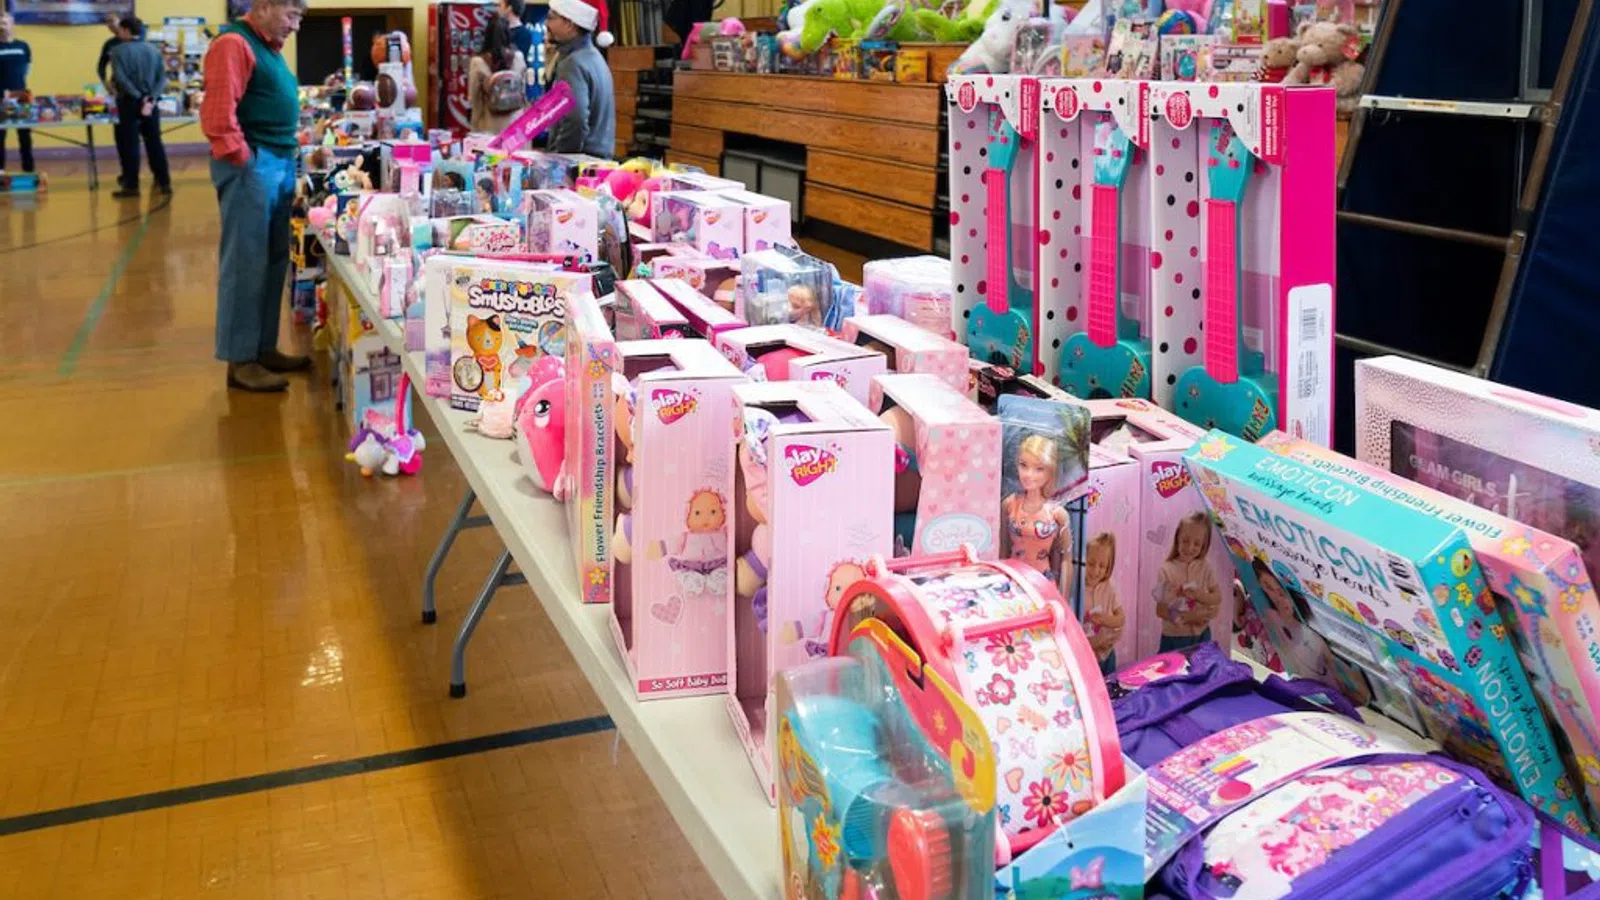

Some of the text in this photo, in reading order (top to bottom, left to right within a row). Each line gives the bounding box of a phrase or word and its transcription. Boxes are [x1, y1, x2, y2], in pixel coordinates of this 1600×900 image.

[594, 403, 606, 456] Bracelets
[793, 456, 838, 480] RIGHT
[1254, 456, 1361, 506] EMOTICON
[1312, 459, 1369, 485] Bracelets
[1452, 471, 1497, 497] GIRLS
[593, 459, 606, 520] Friendship
[1372, 479, 1442, 516] Friendship
[595, 521, 606, 562] Flower
[1235, 495, 1392, 592] EMOTICON
[1445, 511, 1502, 538] Flower
[1257, 531, 1329, 579] message
[651, 680, 664, 690] So
[666, 678, 685, 689] Soft
[1475, 660, 1541, 789] EMOTICON
